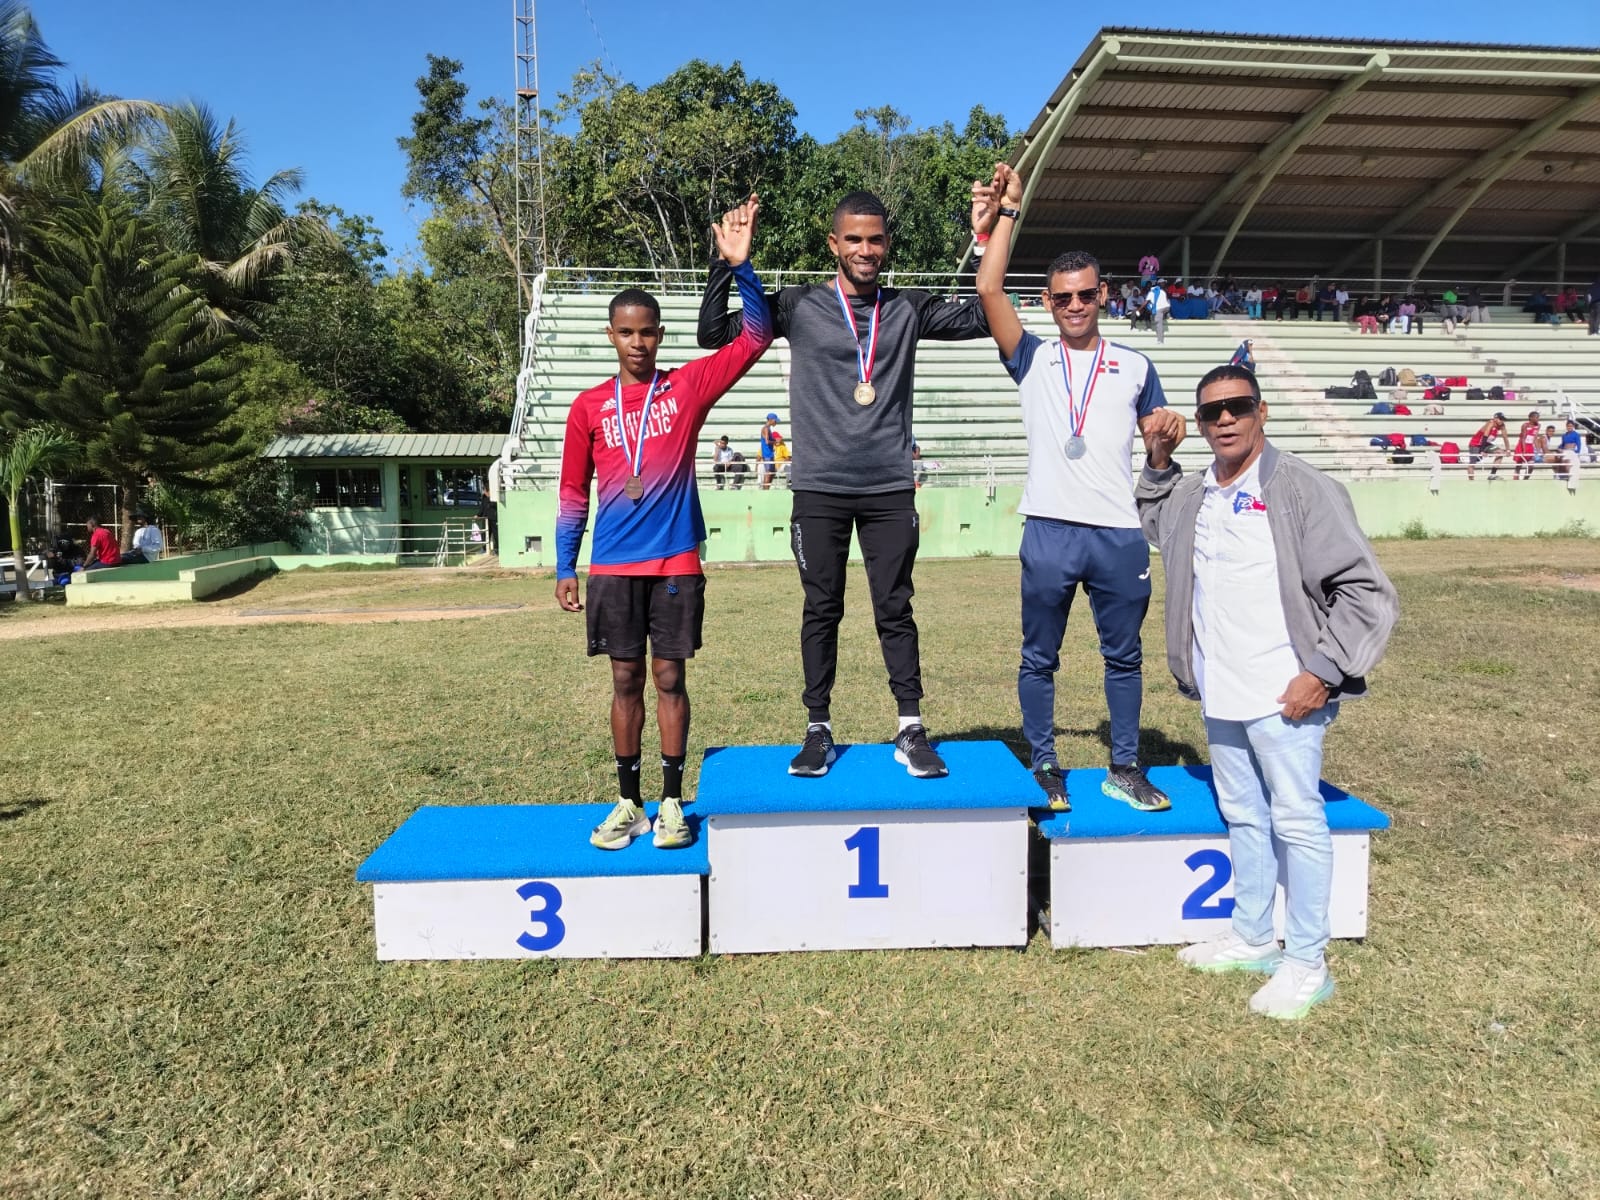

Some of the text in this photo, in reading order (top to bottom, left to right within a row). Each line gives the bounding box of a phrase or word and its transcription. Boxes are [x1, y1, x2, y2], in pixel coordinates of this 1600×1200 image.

[601, 397, 678, 432] DOMICAN
[604, 417, 672, 448] REUBLIC
[844, 827, 888, 898] 1
[1182, 849, 1236, 920] 2
[516, 881, 565, 951] 3
